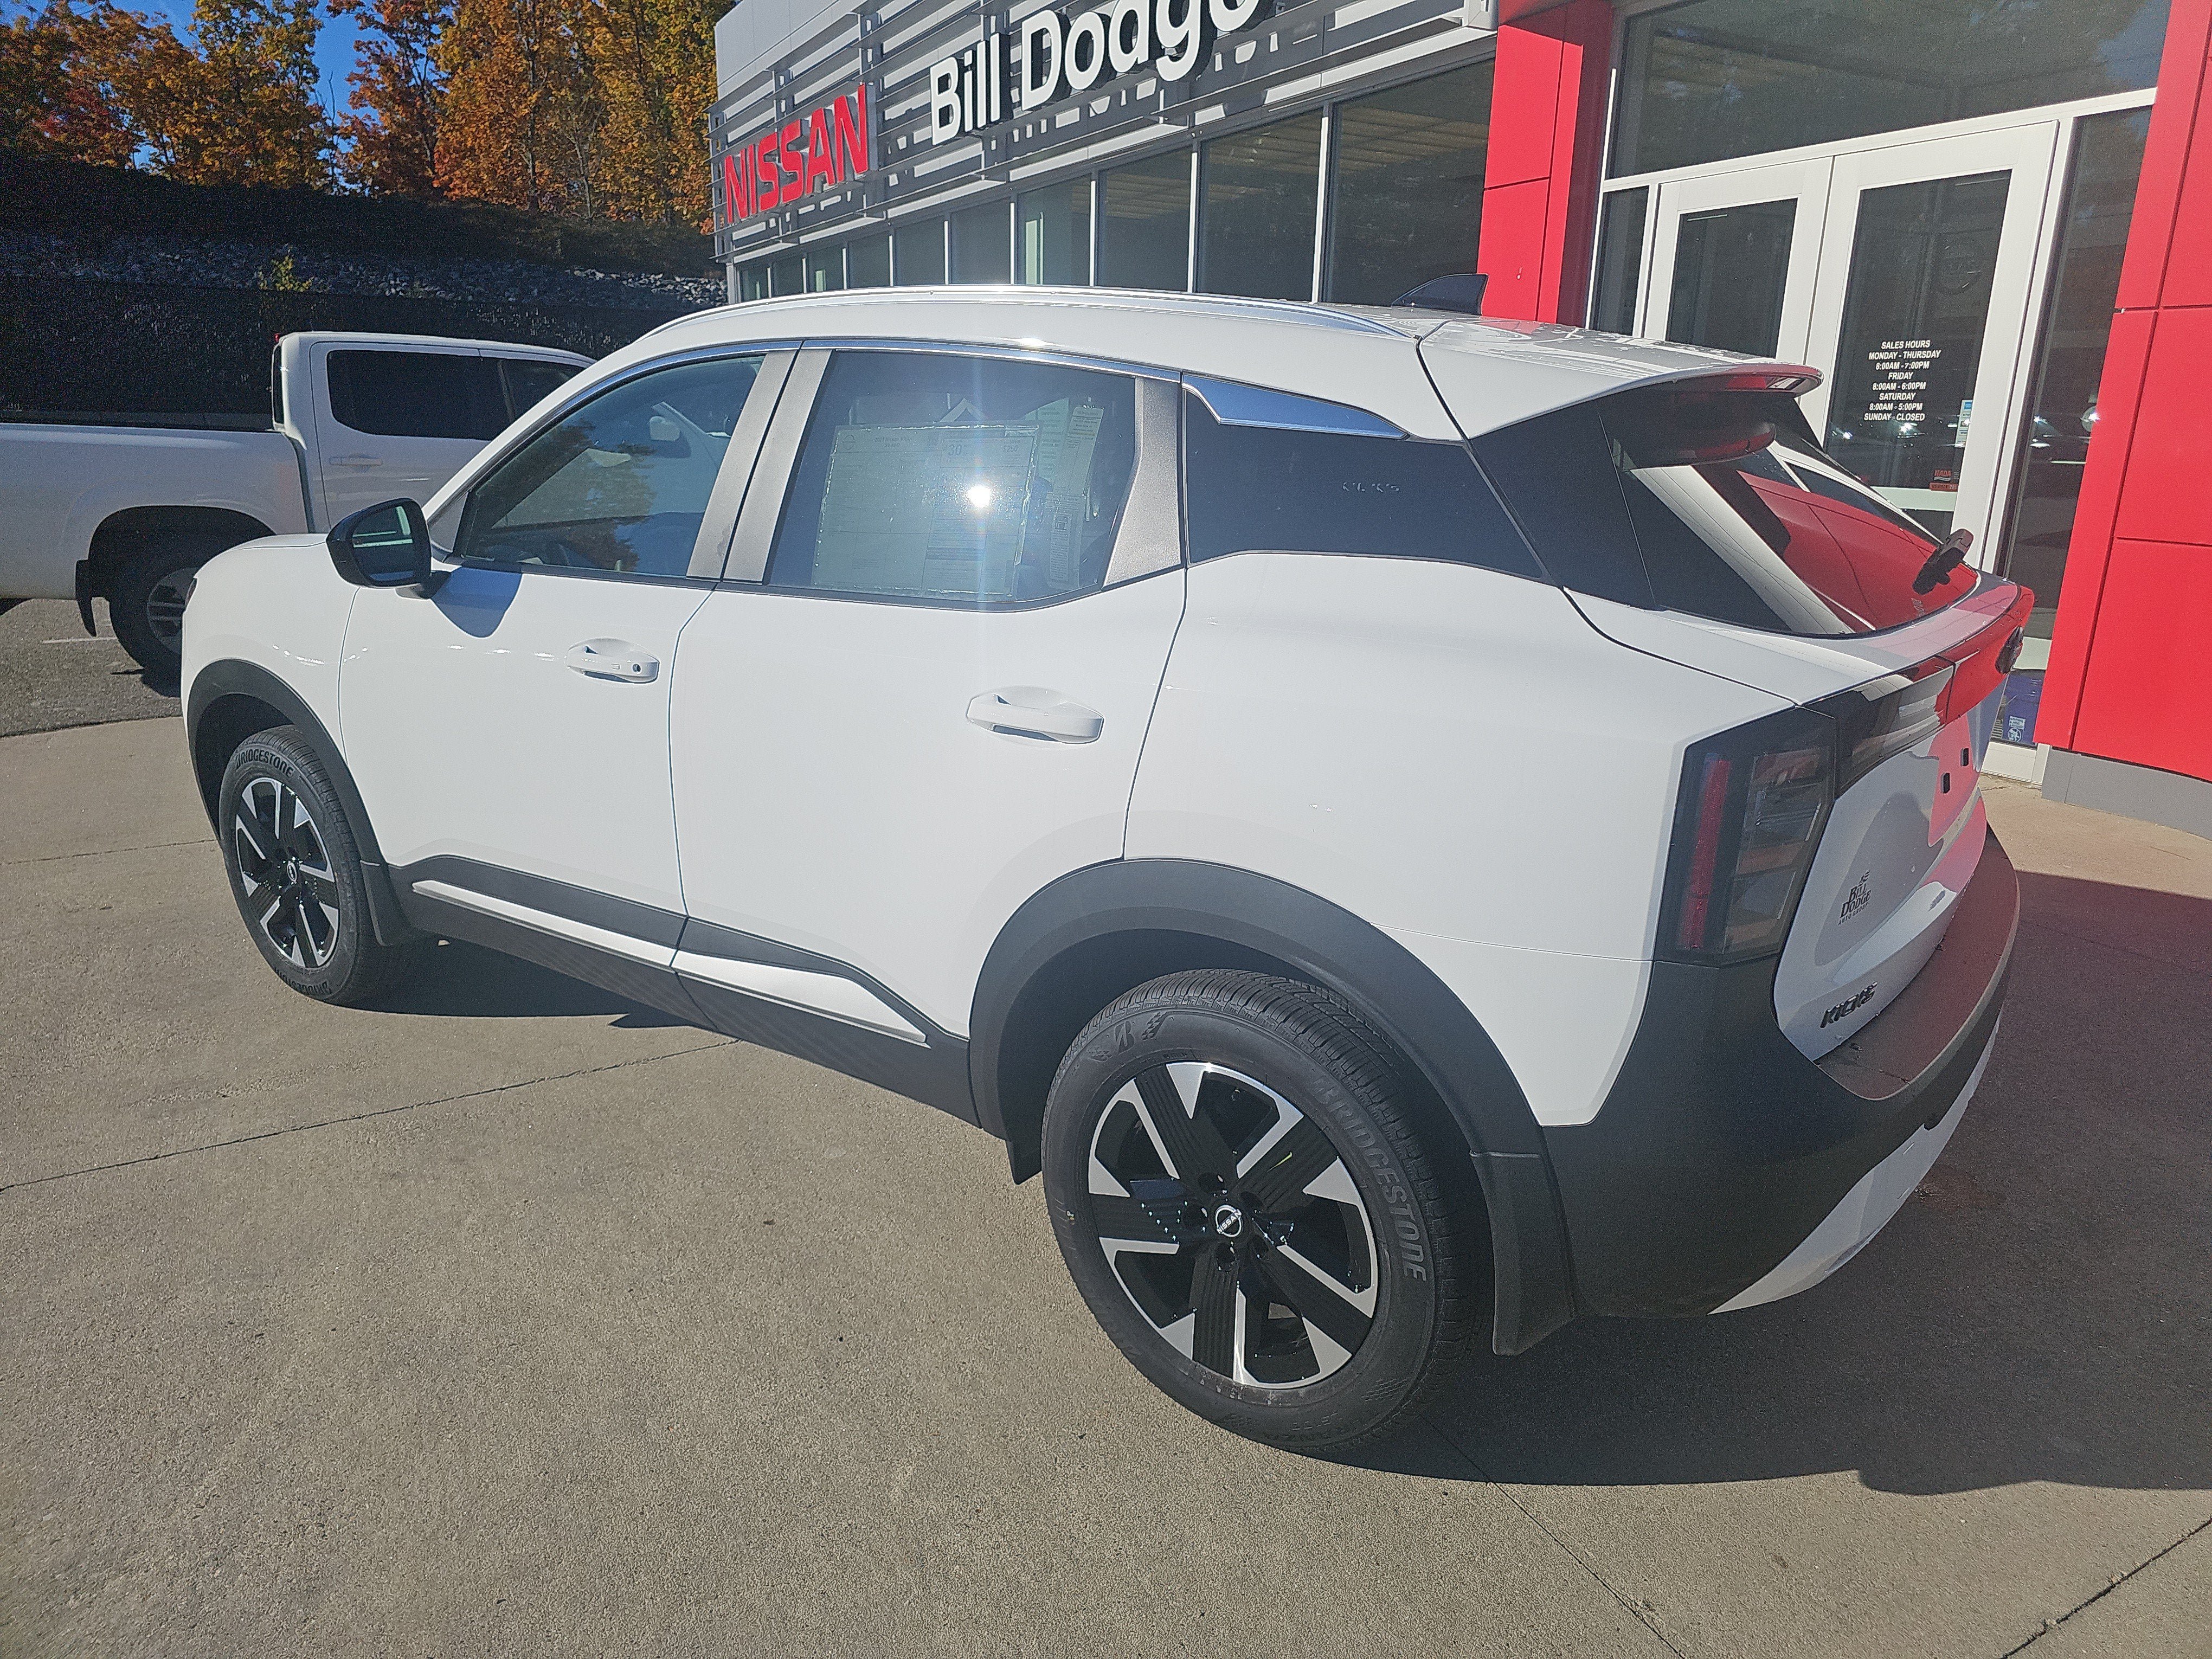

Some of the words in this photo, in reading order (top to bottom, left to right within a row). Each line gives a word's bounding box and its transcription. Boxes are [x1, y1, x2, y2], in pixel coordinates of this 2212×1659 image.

[930, 34, 1000, 145] Bill
[724, 83, 868, 224] NISSAN
[1881, 341, 1904, 349] SALES
[1905, 340, 1931, 348] HOURS
[1868, 351, 1898, 360] MONDAY
[1903, 350, 1941, 359] THURSDAY
[1875, 362, 1900, 370] 8:00AM
[1905, 361, 1930, 369] 7:00PM
[1888, 372, 1914, 380] FRIDAY
[1872, 382, 1896, 390] 8:00AM
[1901, 382, 1927, 390] 6:00PM
[1879, 392, 1916, 400] SATURDAY
[1898, 402, 1923, 410] 5:00PM
[1864, 413, 1892, 421] SUNDAY
[1896, 413, 1925, 421] CLOSED
[236, 749, 294, 779] BRIDGESTONE
[1848, 883, 1867, 903] BILL
[1839, 890, 1872, 919] DODGE
[1819, 981, 1878, 1028] KICKS
[1311, 1076, 1427, 1282] BRIDGESTONE
[1217, 1208, 1242, 1234] NISSAN
